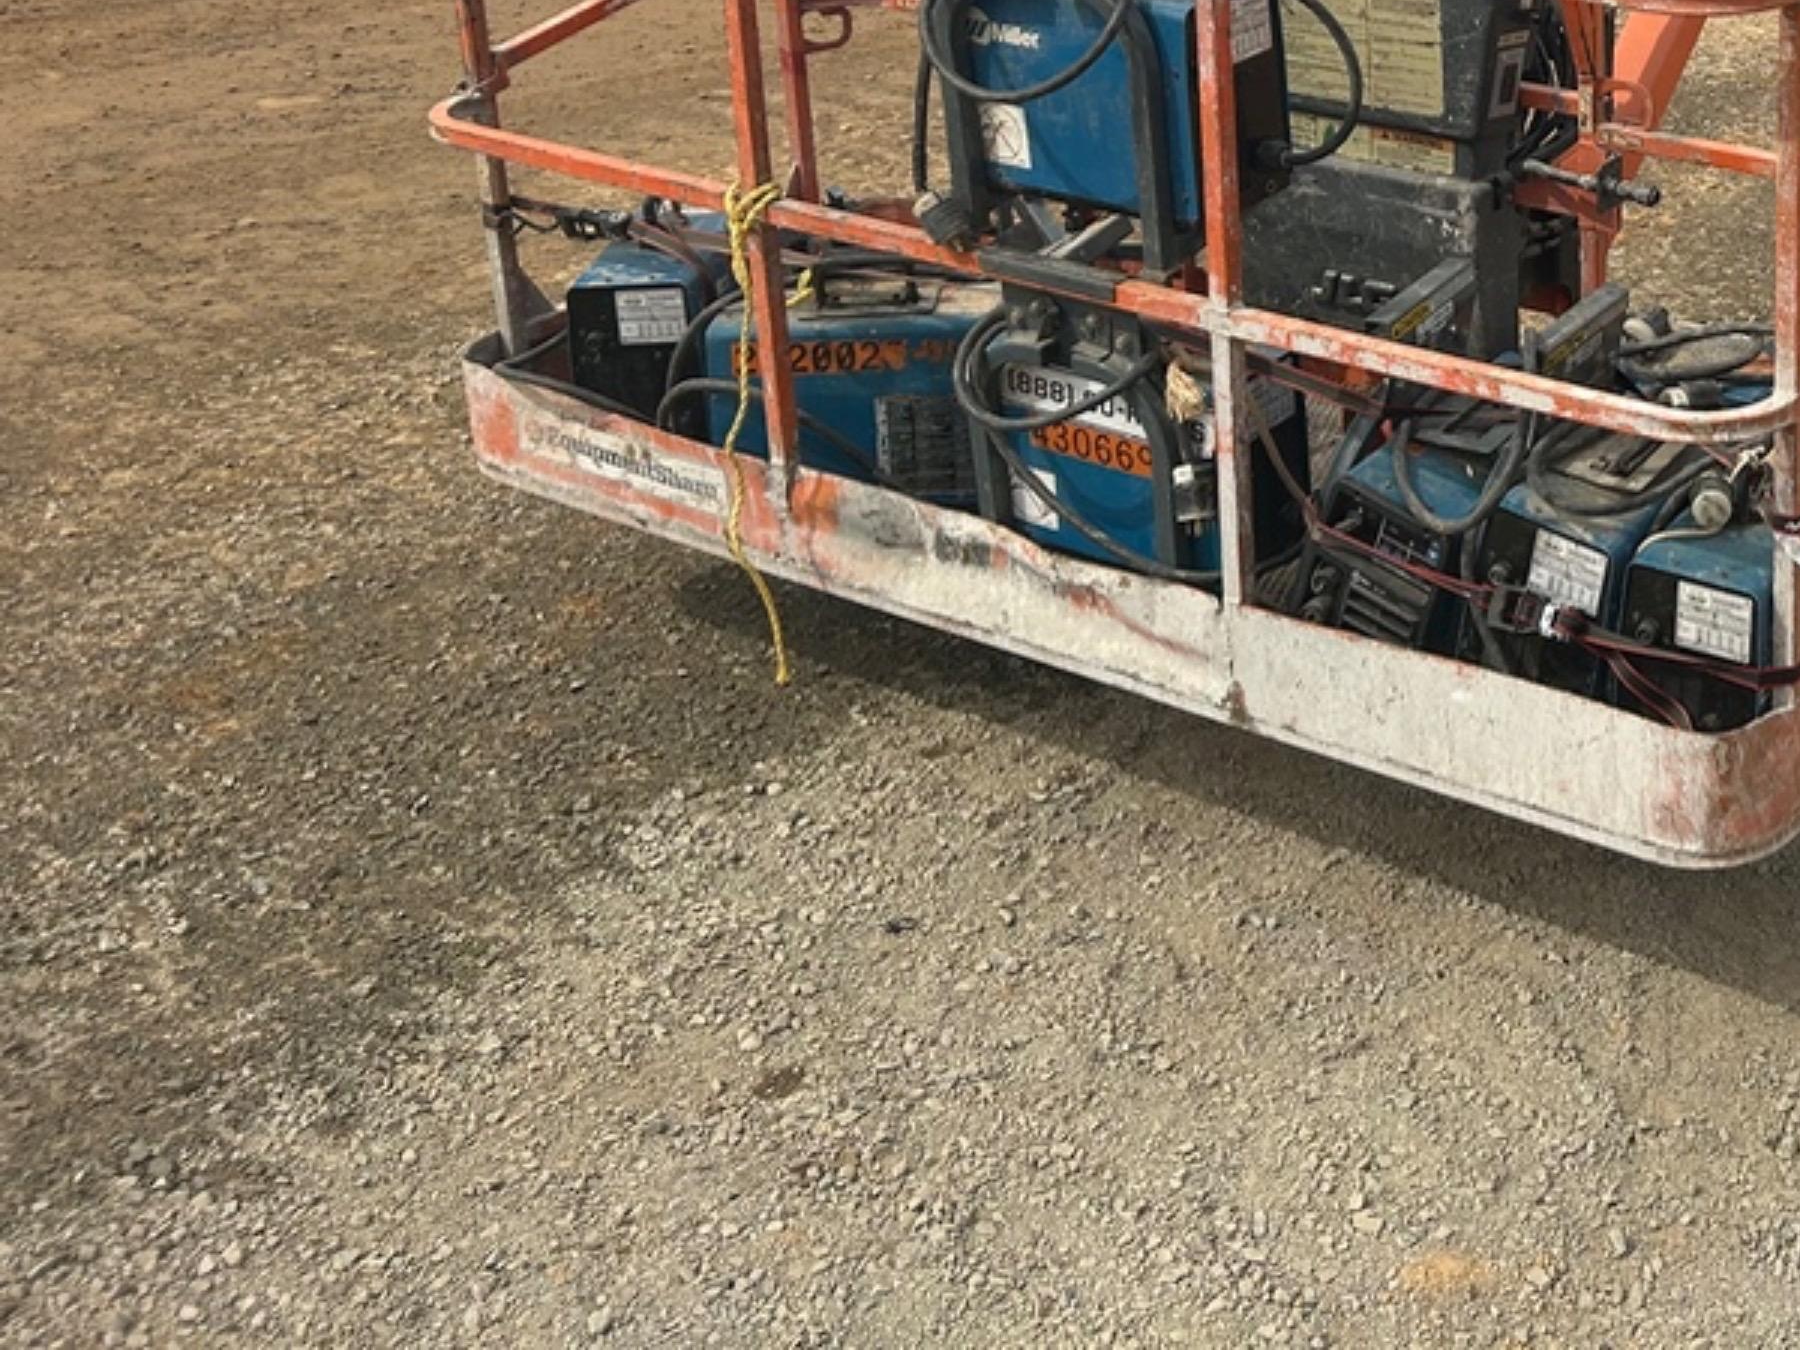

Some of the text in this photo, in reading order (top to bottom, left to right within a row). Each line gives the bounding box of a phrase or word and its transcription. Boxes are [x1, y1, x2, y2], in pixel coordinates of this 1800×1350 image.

[991, 22, 1040, 50] Miller
[1006, 368, 1074, 410] (888)
[547, 425, 718, 501] EquipmentShare
